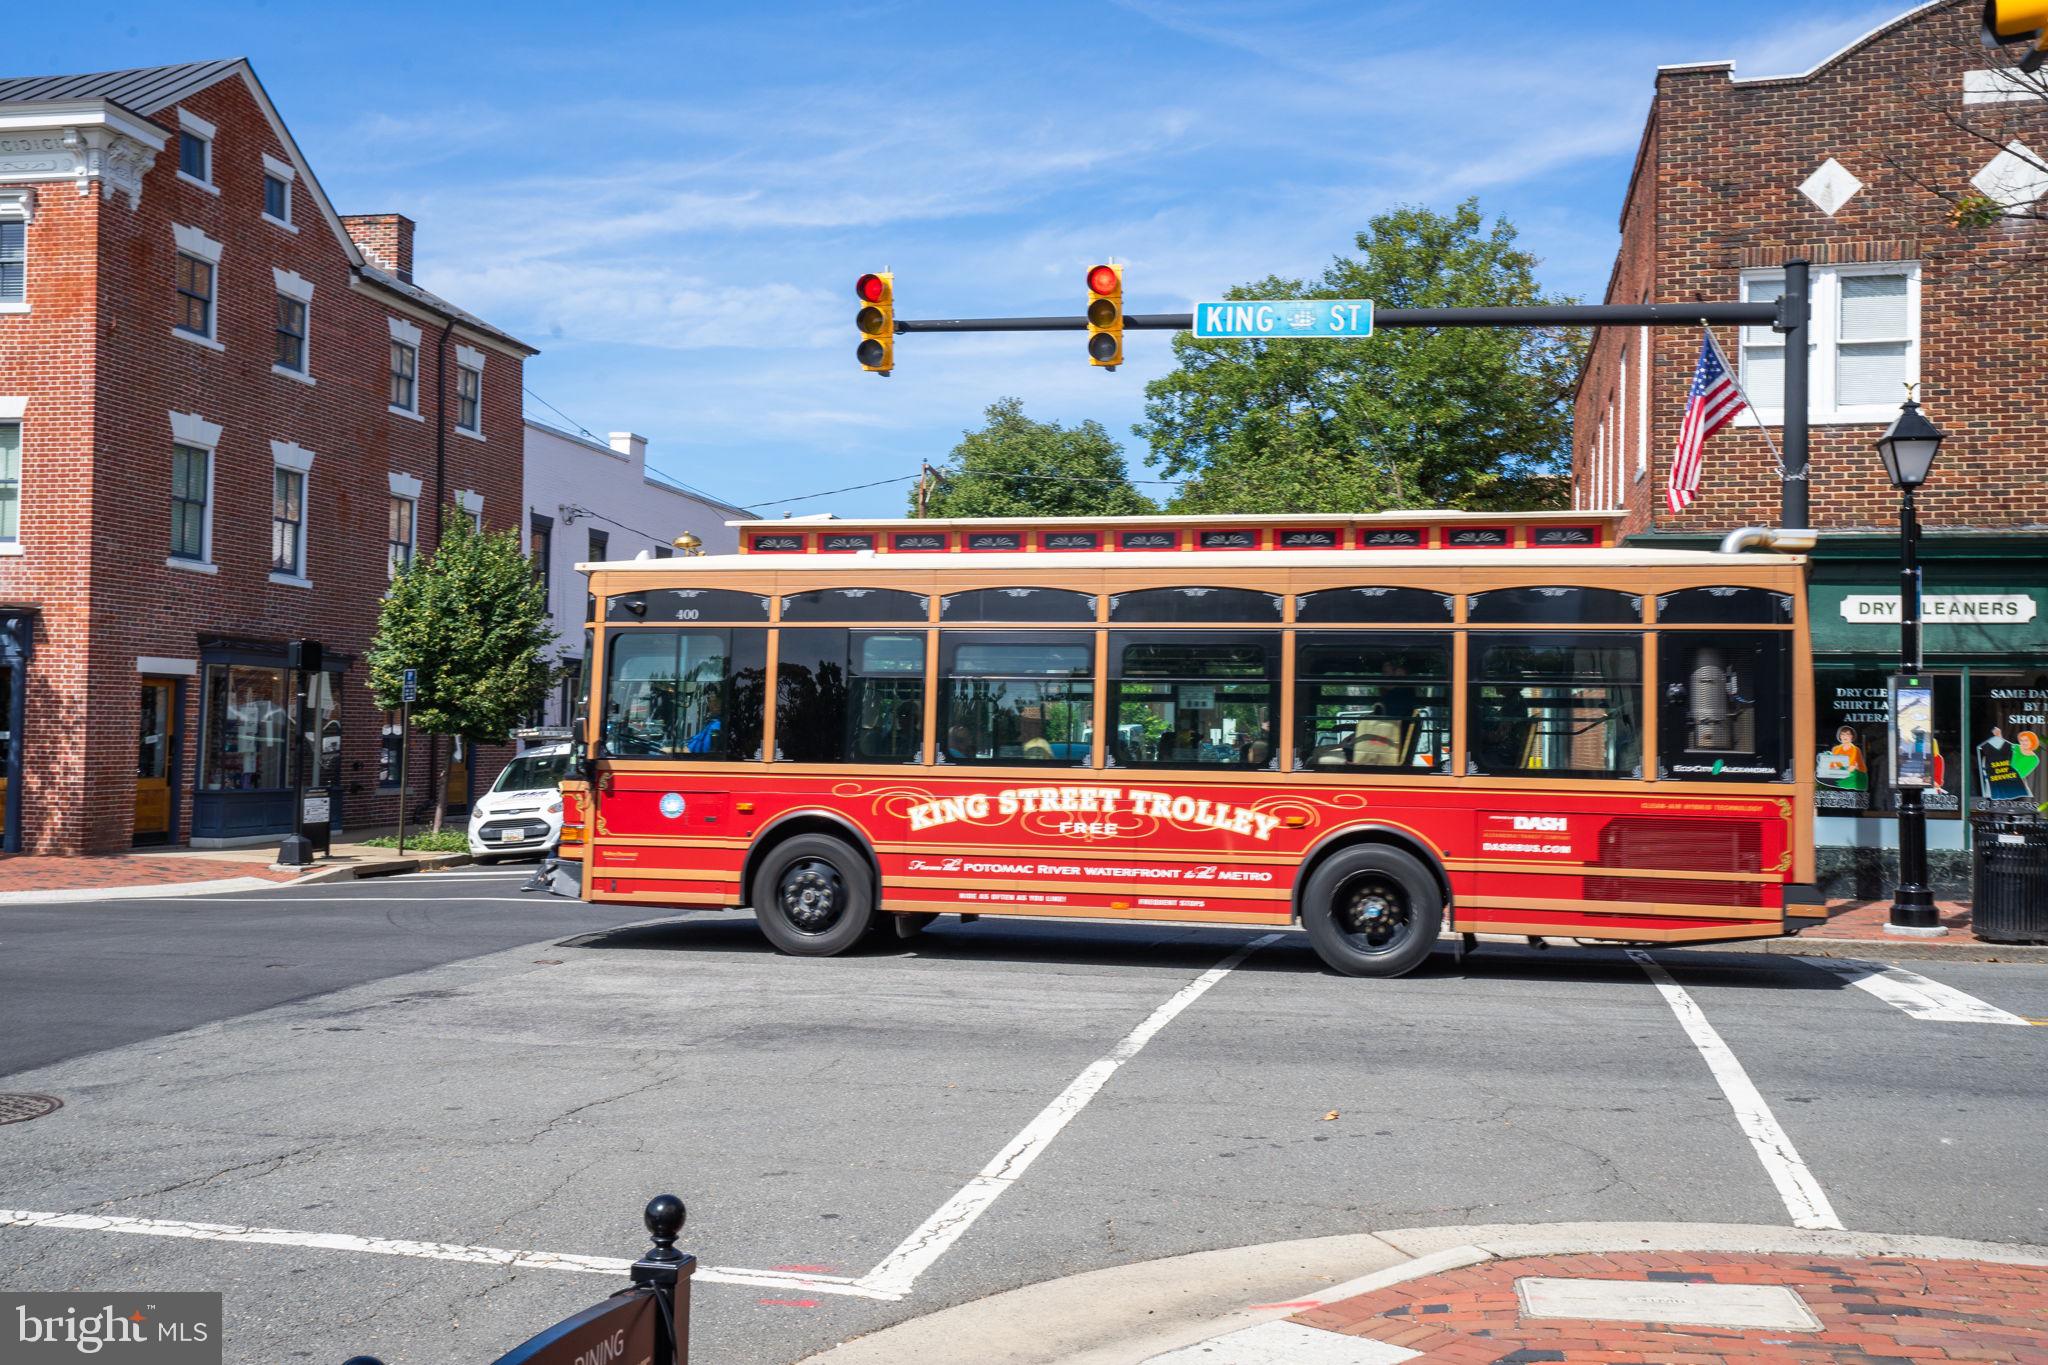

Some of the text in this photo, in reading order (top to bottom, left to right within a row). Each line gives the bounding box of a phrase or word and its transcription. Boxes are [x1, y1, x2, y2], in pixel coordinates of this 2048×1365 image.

[1206, 304, 1362, 332] KING ST
[1859, 601, 2018, 616] DRY LEANERS
[675, 609, 699, 620] 400
[1836, 688, 1888, 697] DRY CLE
[1991, 689, 2048, 699] SAME DA
[1833, 700, 1889, 710] SHIRT LA
[2024, 702, 2042, 711] BY
[1844, 713, 1889, 722] ALTERA
[2009, 714, 2046, 724] SHOE
[1990, 760, 2010, 769] SAME
[1990, 772, 2018, 782] SERVICE
[907, 786, 1282, 841] KING STREET TROLLEY
[1059, 822, 1118, 835] FREE
[1513, 816, 1567, 831] DASH
[1482, 843, 1572, 854] DASHBUS.COM
[963, 863, 1034, 874] POTOMAC
[1037, 865, 1081, 876] RIVER
[1083, 867, 1182, 879] WATERFRONT
[1218, 871, 1273, 881] METRO
